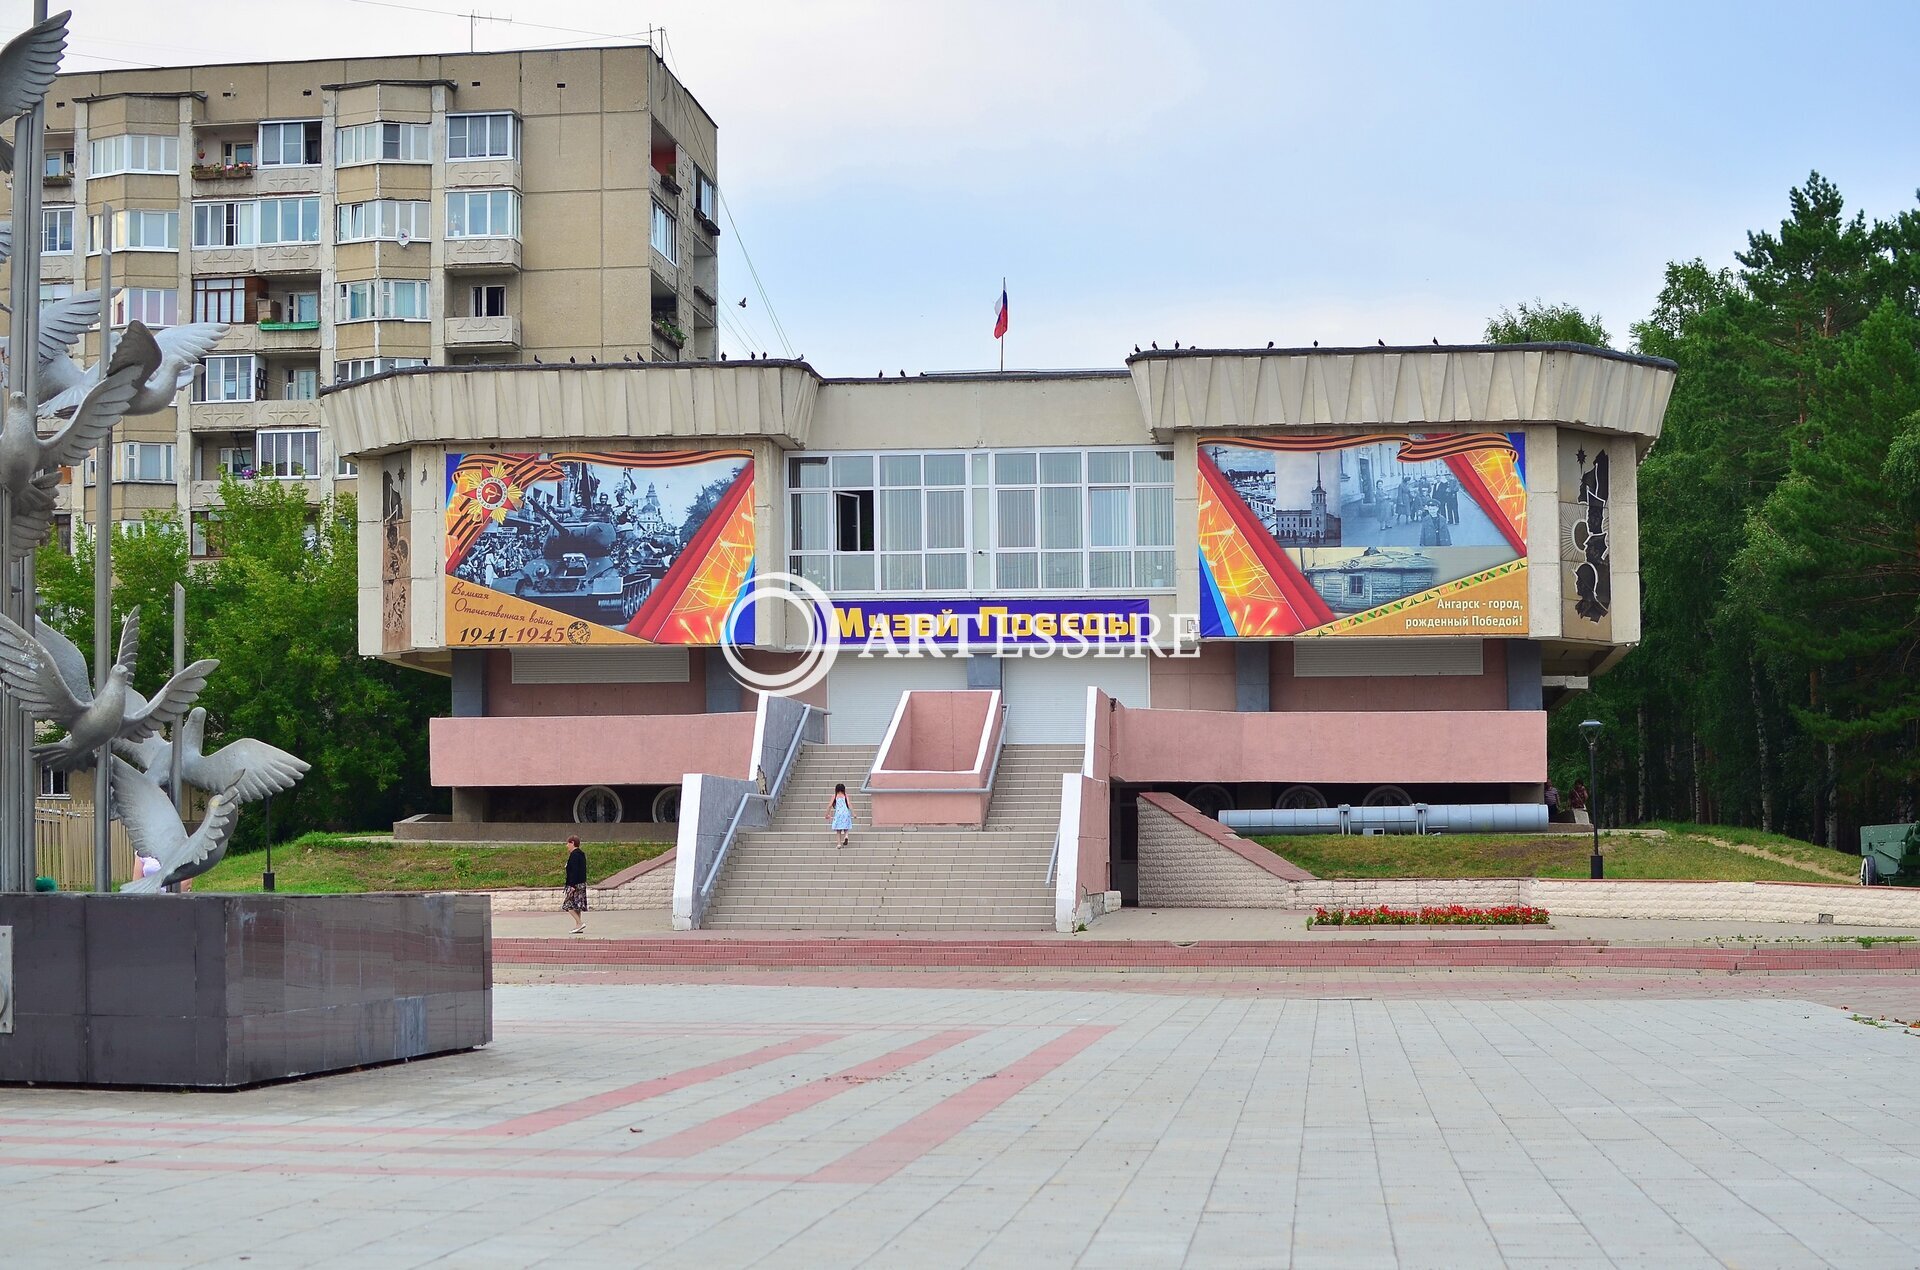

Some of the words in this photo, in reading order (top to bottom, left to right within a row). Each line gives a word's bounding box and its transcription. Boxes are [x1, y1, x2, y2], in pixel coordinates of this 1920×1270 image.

[451, 581, 489, 600] Великая
[454, 598, 525, 622] Отечественная
[528, 610, 554, 626] война
[1437, 599, 1480, 611] Ангарск
[1488, 600, 1523, 611] город,
[1405, 617, 1469, 629] рожденный
[1471, 615, 1523, 628] Победой!
[460, 627, 565, 643] 1941-1945
